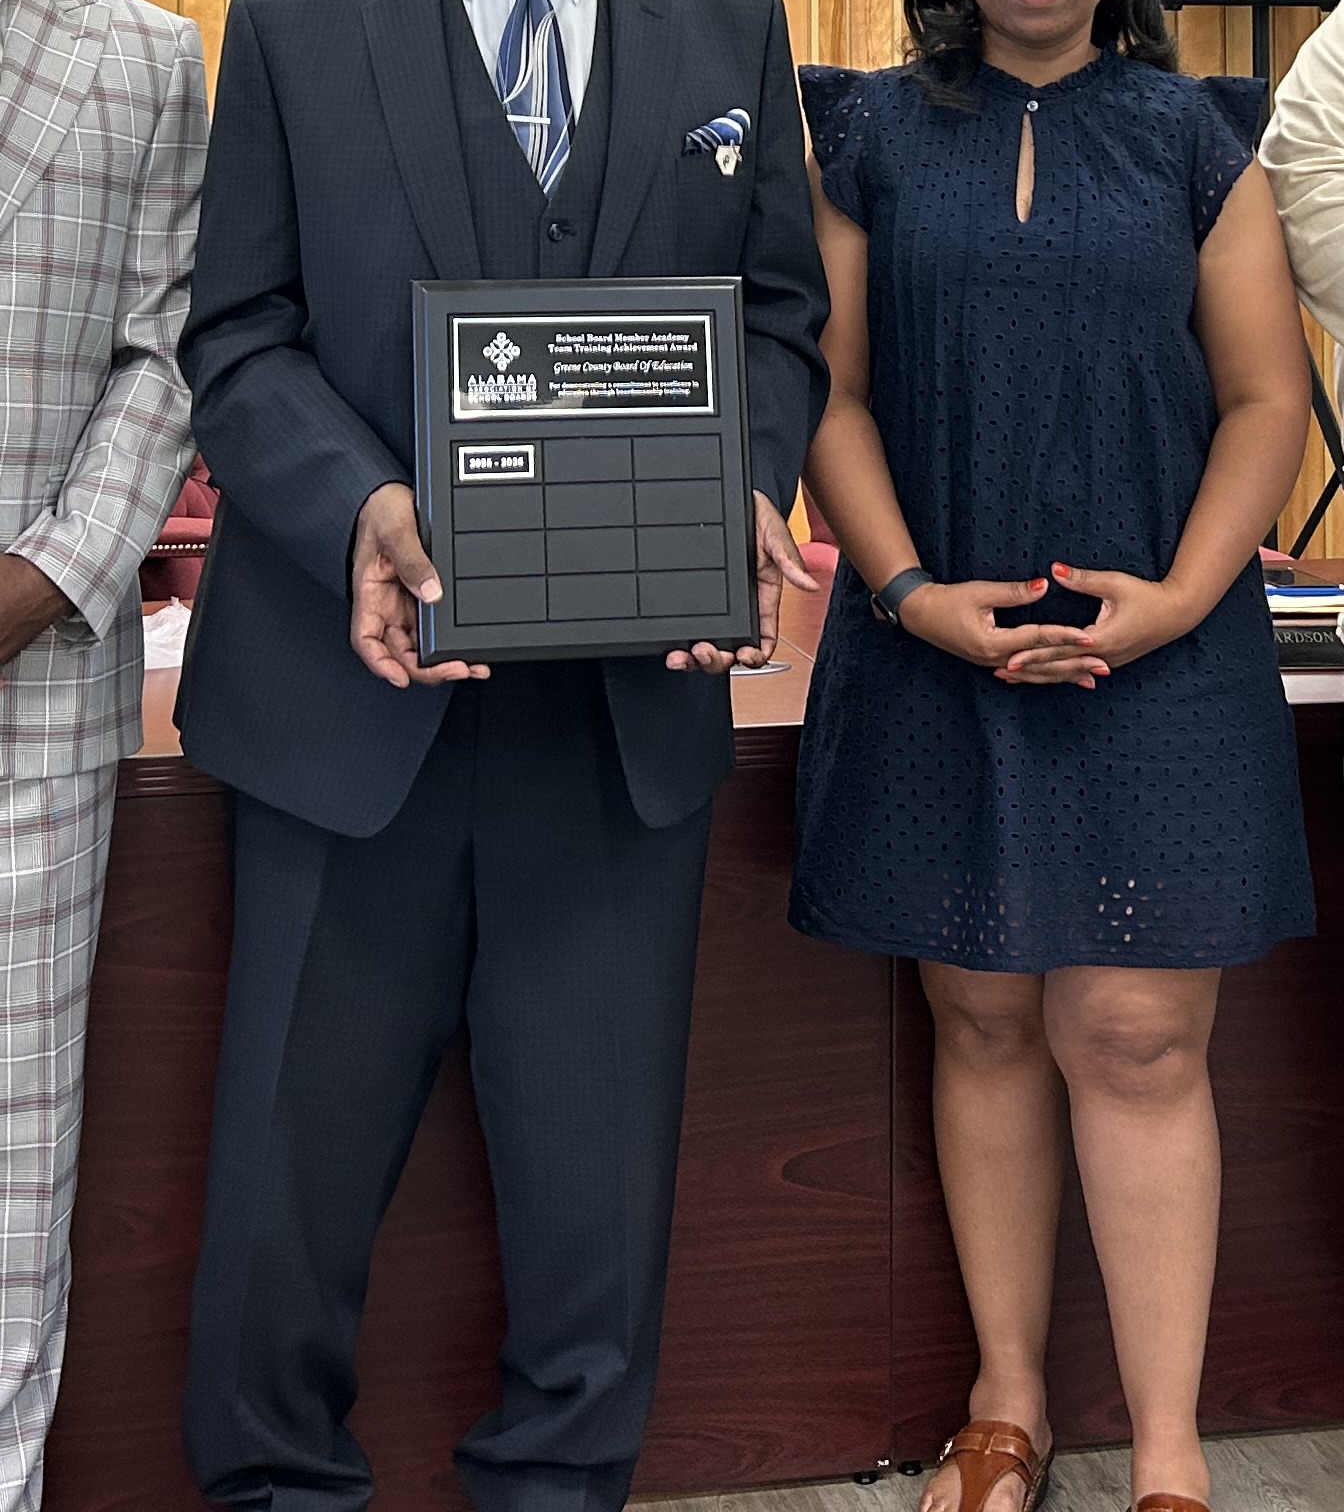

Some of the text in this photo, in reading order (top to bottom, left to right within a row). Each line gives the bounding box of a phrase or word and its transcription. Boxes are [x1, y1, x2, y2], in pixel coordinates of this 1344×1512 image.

[555, 333, 585, 343] School
[586, 333, 613, 343] Board
[650, 332, 690, 344] Academy
[573, 343, 612, 355] Training
[669, 342, 698, 352] Award
